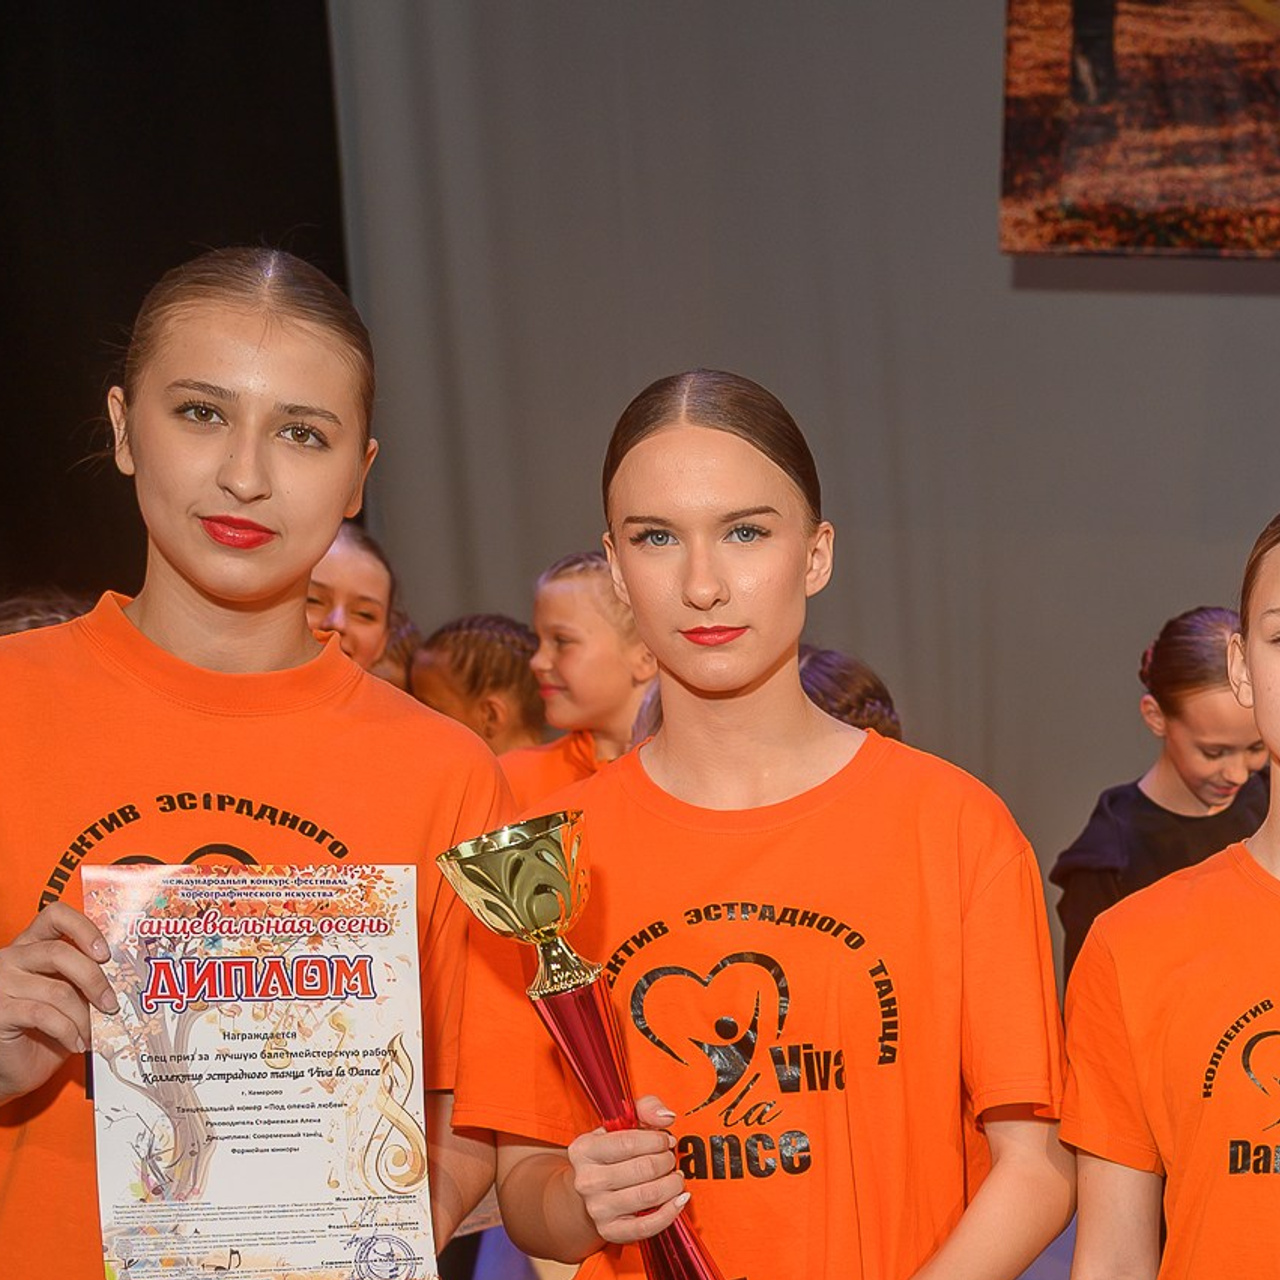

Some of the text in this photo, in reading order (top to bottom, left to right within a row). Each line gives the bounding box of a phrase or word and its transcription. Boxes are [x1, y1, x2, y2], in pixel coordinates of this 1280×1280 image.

[38, 804, 141, 912] ЛЛЕКТИВ
[285, 891, 334, 900] искусства
[319, 917, 390, 934] осень
[142, 955, 377, 1014] ДИПЛОМ
[684, 902, 866, 951] ЭСТРАДНОГО
[868, 959, 899, 1065] ТАНЦА
[140, 1053, 167, 1063] Спец
[198, 1053, 210, 1061] за
[214, 1051, 257, 1061] лучшую
[260, 1048, 360, 1059] балетмейстерскую
[362, 1046, 398, 1057] работу
[223, 1031, 297, 1041] Награждается
[1202, 999, 1274, 1098] КОЛЛЕКТИВ
[205, 1069, 268, 1083] эстрадного
[270, 1070, 304, 1080] танца
[307, 1066, 333, 1077] Viva
[335, 1066, 346, 1076] la
[348, 1066, 381, 1076] Dance
[769, 1043, 846, 1093] Viva
[718, 1073, 783, 1127] la
[664, 1129, 812, 1180] ance
